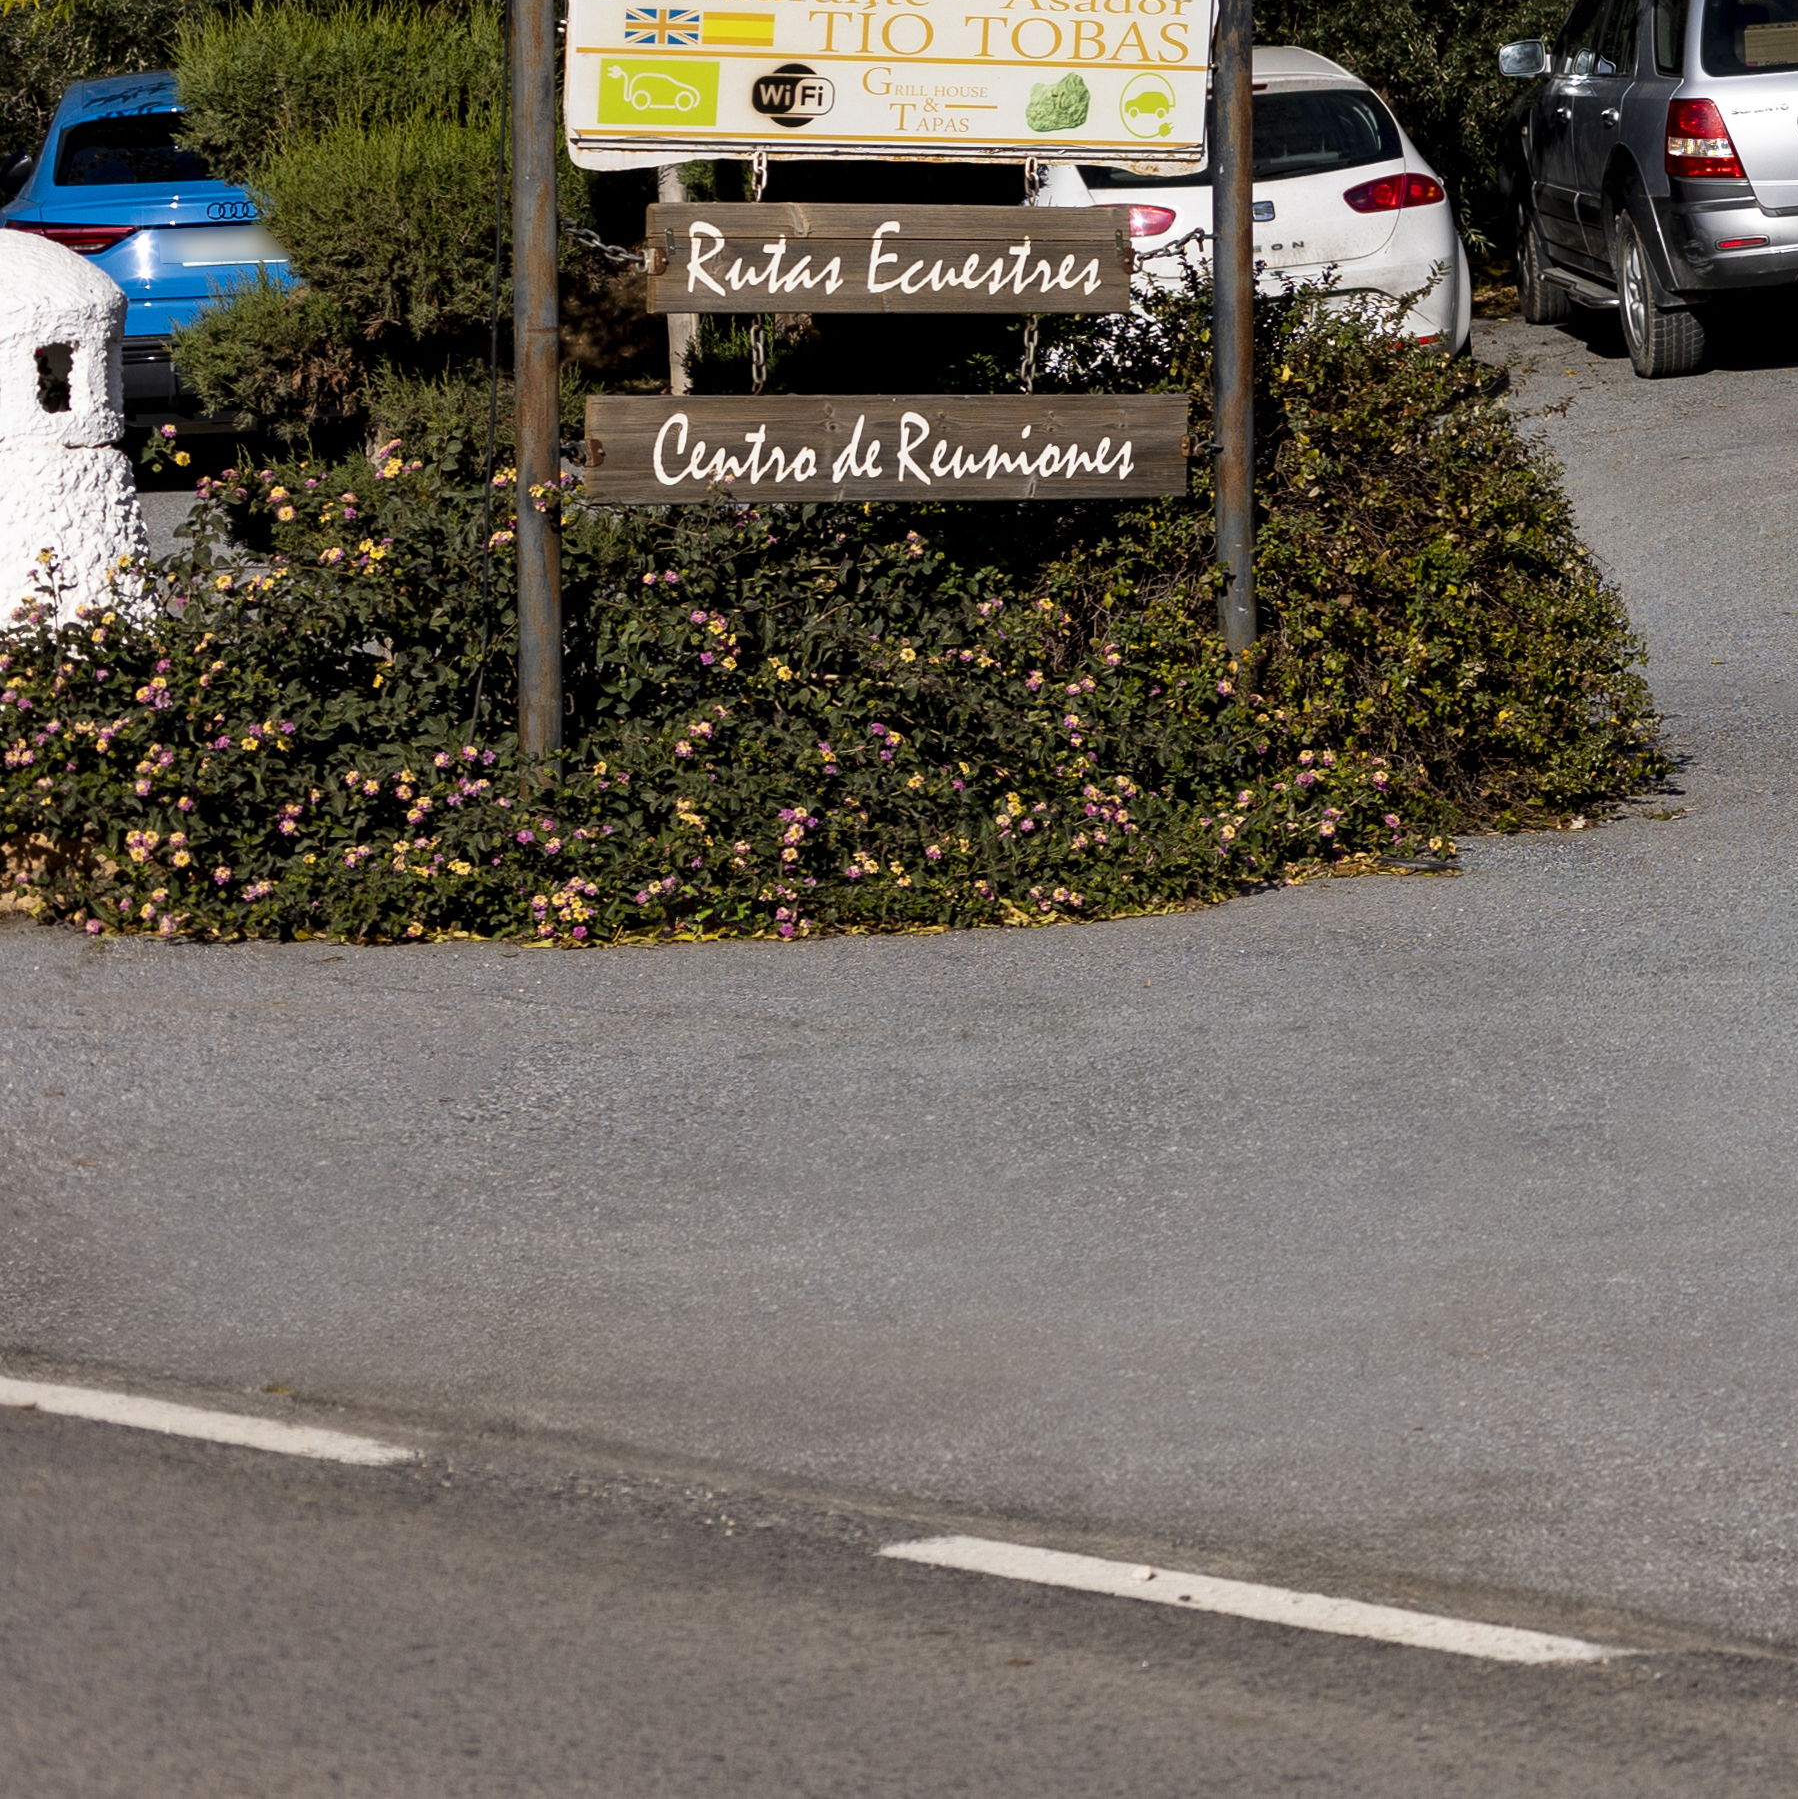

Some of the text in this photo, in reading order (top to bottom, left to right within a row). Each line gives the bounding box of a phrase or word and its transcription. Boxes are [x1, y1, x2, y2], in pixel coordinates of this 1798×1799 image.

[809, 1, 1191, 64] TÍO TOBAS
[862, 66, 988, 98] GRILL HOUSE
[922, 97, 939, 113] &
[889, 102, 970, 133] TAPAS
[686, 220, 1102, 297] Rutas Ecuestres
[653, 411, 1134, 486] Centro de Reuniones
